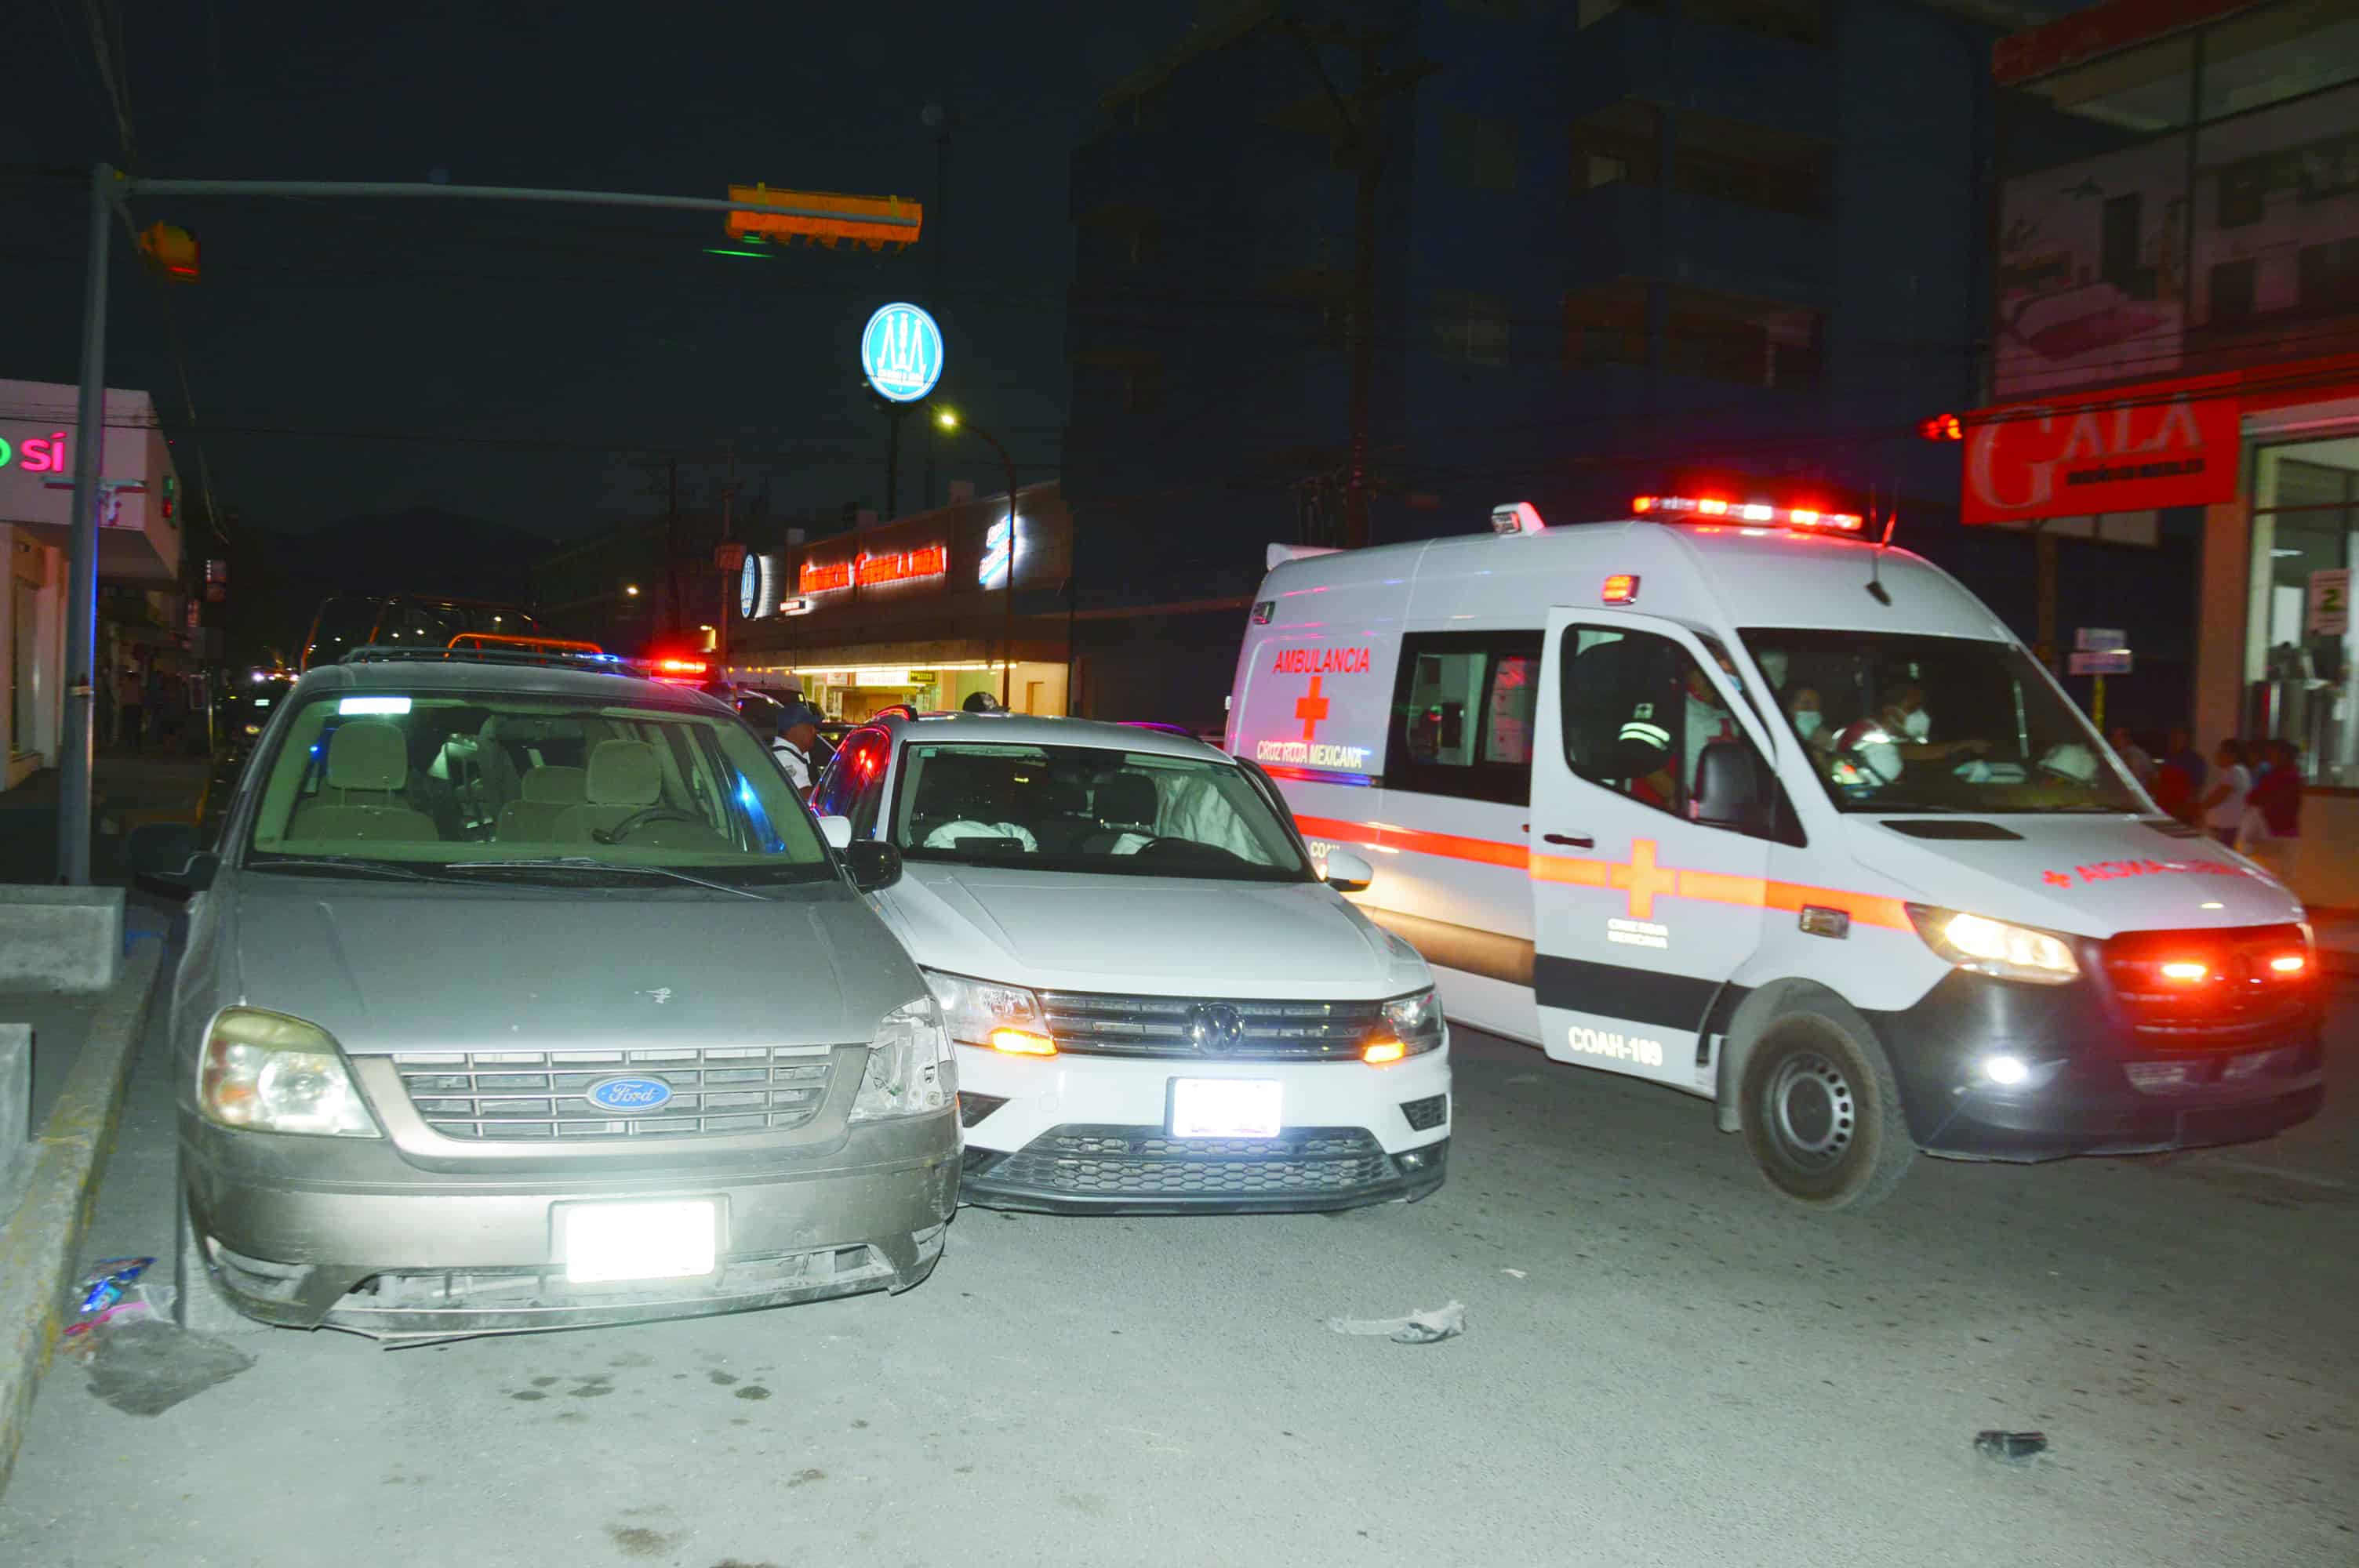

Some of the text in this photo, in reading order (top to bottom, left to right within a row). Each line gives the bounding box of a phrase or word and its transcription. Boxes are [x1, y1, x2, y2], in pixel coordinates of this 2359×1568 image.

[20, 431, 67, 473] sí
[1969, 391, 2206, 510] GALA
[2317, 588, 2342, 612] 2
[1272, 646, 1371, 675] AMBULANCIA
[1256, 739, 1363, 769] CRUZ ROJA MEXICANA
[608, 1083, 660, 1103] Ford
